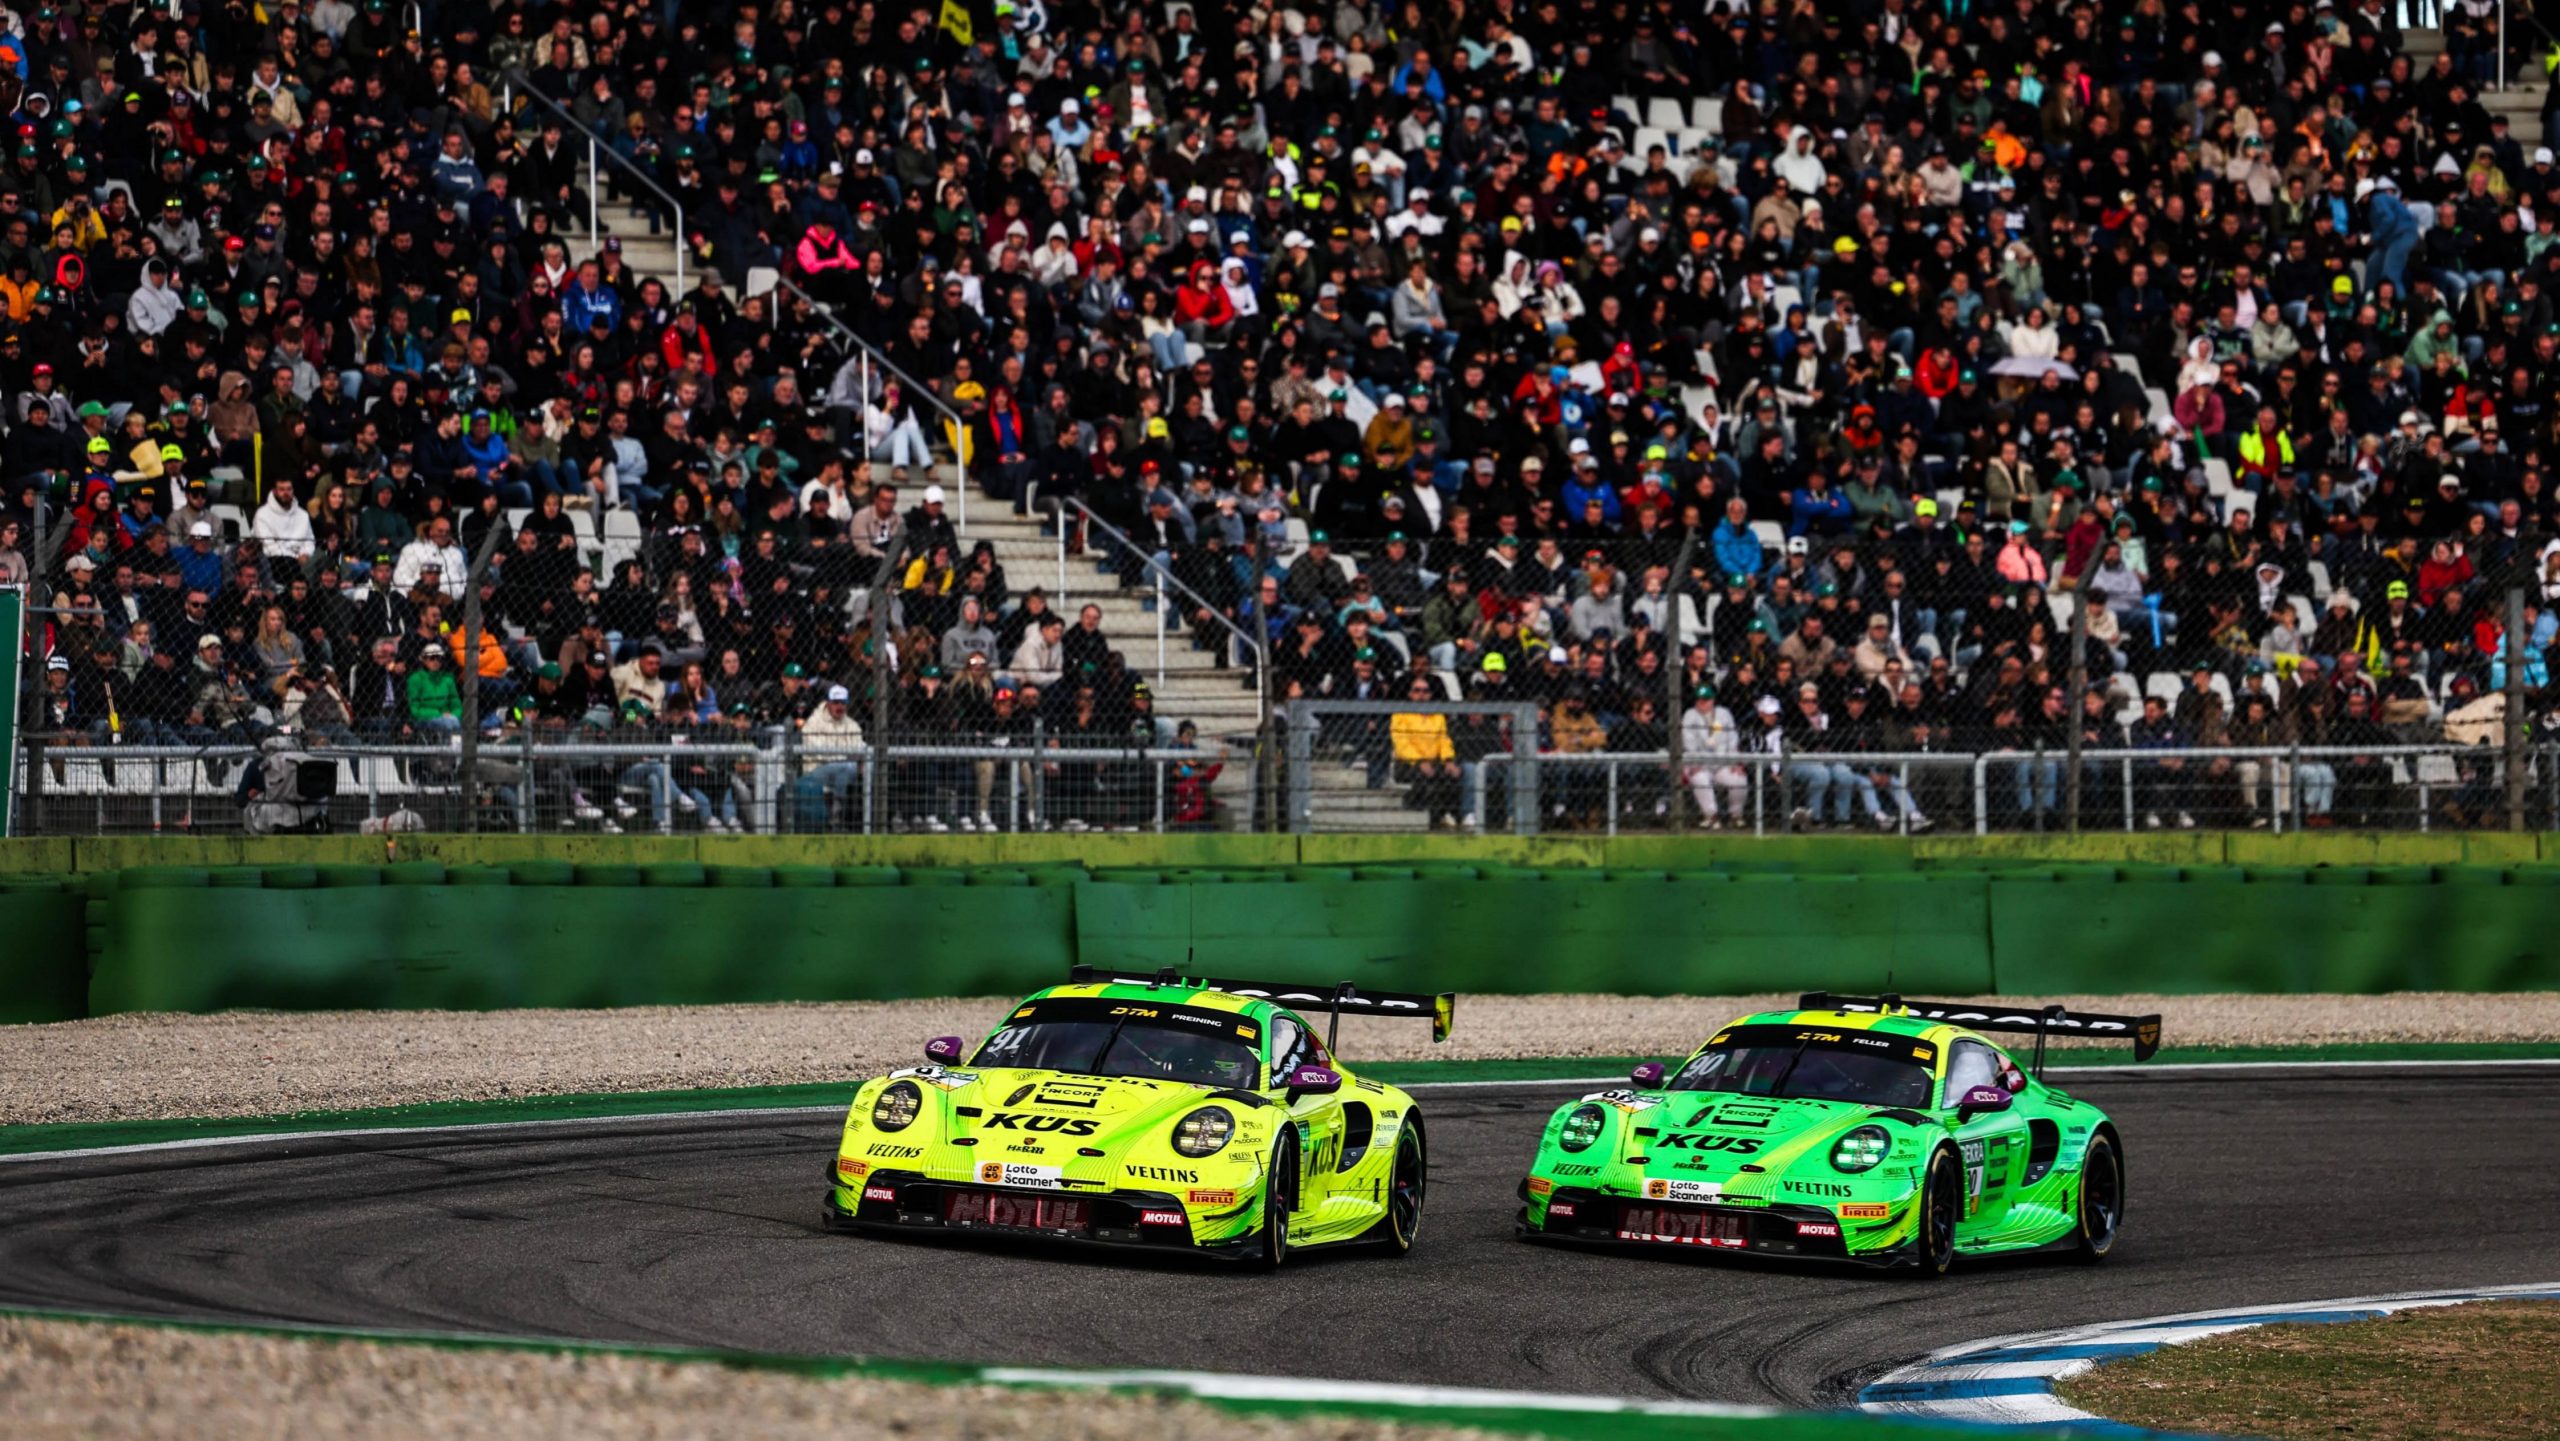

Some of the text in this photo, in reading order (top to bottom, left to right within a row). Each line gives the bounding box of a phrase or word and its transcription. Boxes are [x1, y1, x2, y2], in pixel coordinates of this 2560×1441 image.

[1110, 1006, 1158, 1018] DTM
[1172, 1014, 1222, 1027] PREINING
[986, 1026, 1032, 1053] 91
[1853, 1038, 1890, 1048] FELLER
[1681, 1054, 1726, 1078] 90
[1719, 1109, 1776, 1118] TRICORP
[866, 1143, 924, 1158] VELTINS
[1005, 1164, 1038, 1175] Lotto
[1126, 1165, 1199, 1183] VELTINS
[1552, 1162, 1601, 1176] VELTINS
[1004, 1173, 1053, 1187] Scanner
[1670, 1181, 1699, 1191] Lotto
[865, 1188, 893, 1200] MOTUL
[1783, 1180, 1853, 1197] VELTINS
[1189, 1190, 1235, 1204] PIRELLI
[1669, 1190, 1714, 1202] Scanner
[950, 1193, 1088, 1230] MOTUL
[1550, 1204, 1574, 1215] MOTUL
[1842, 1205, 1887, 1216] PIRELLI
[1143, 1212, 1182, 1224] MOTUL
[1619, 1208, 1743, 1245] MOTUL
[1799, 1225, 1837, 1235] MOTUL
